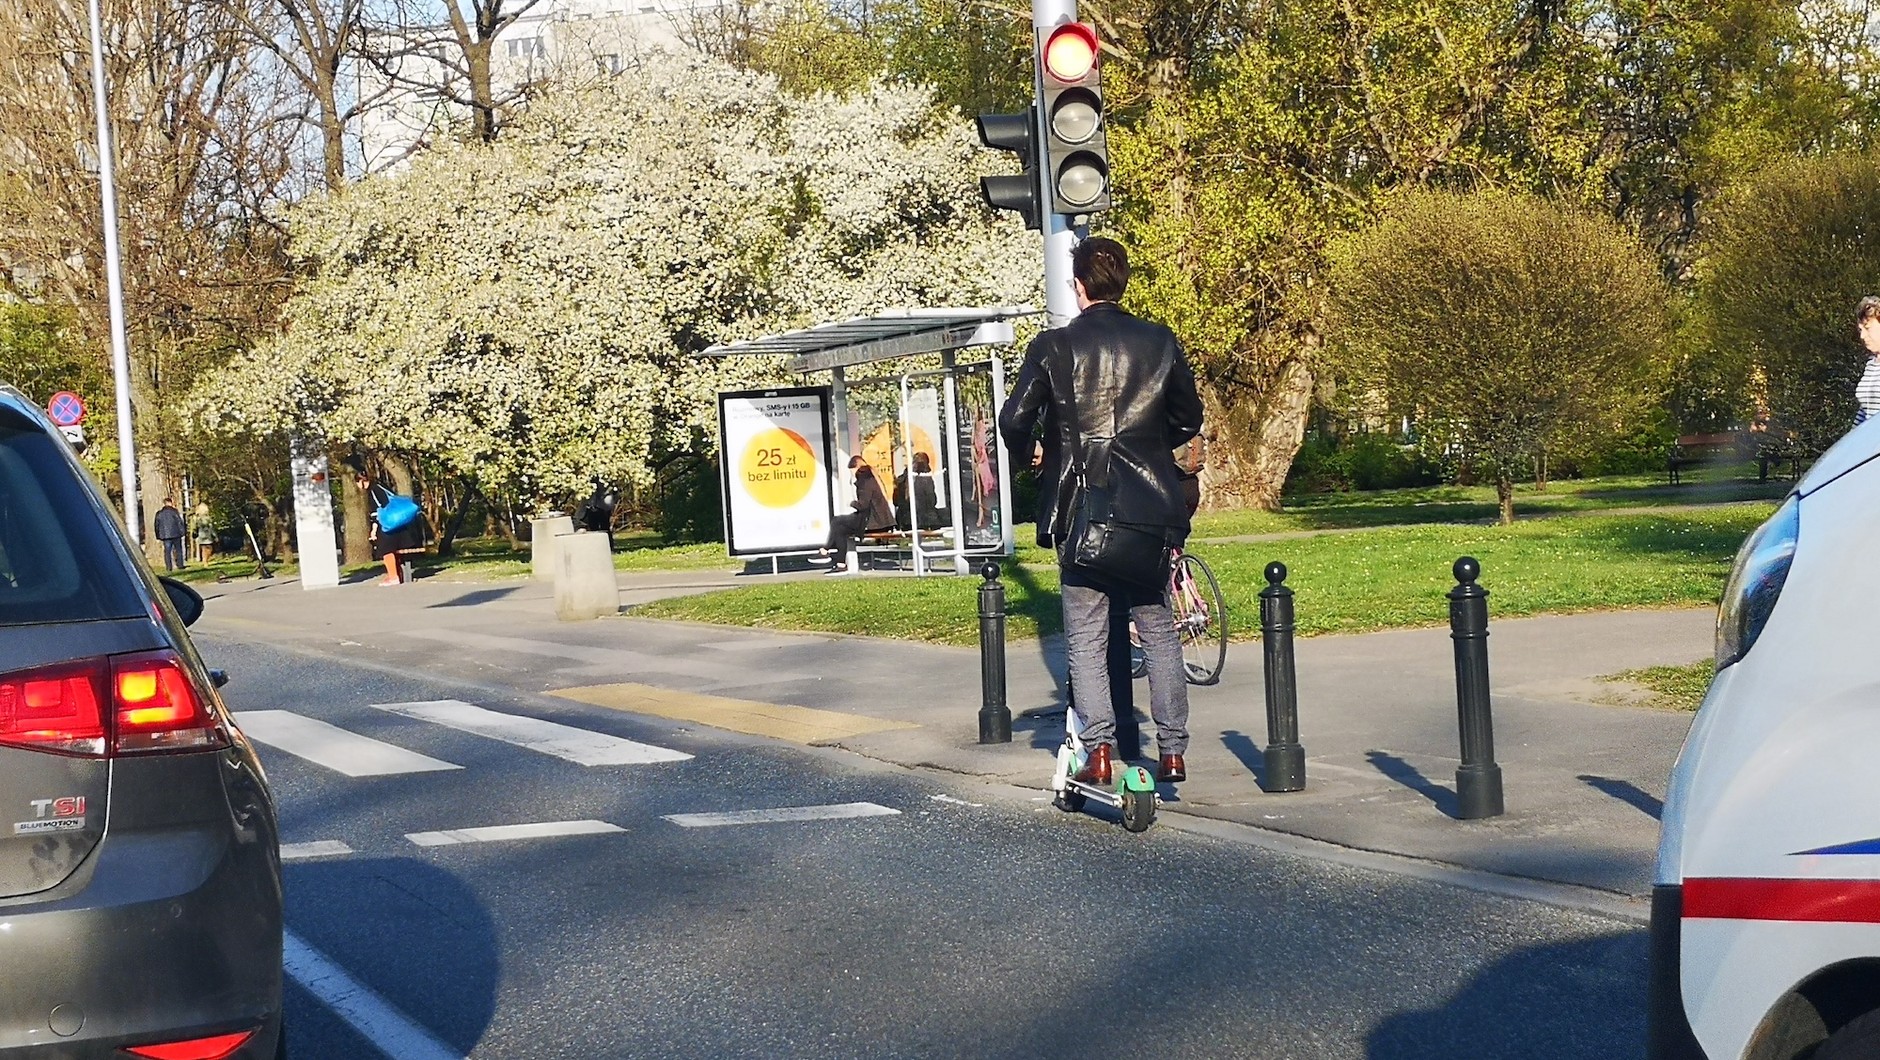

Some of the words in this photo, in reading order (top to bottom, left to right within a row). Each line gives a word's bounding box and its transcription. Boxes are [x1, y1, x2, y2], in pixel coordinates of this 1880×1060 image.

[757, 448, 782, 467] 25
[786, 454, 796, 465] zł
[748, 471, 770, 482] bez
[773, 469, 807, 480] limitu
[30, 796, 86, 818] TSI
[20, 820, 79, 830] BLUEMOTION
